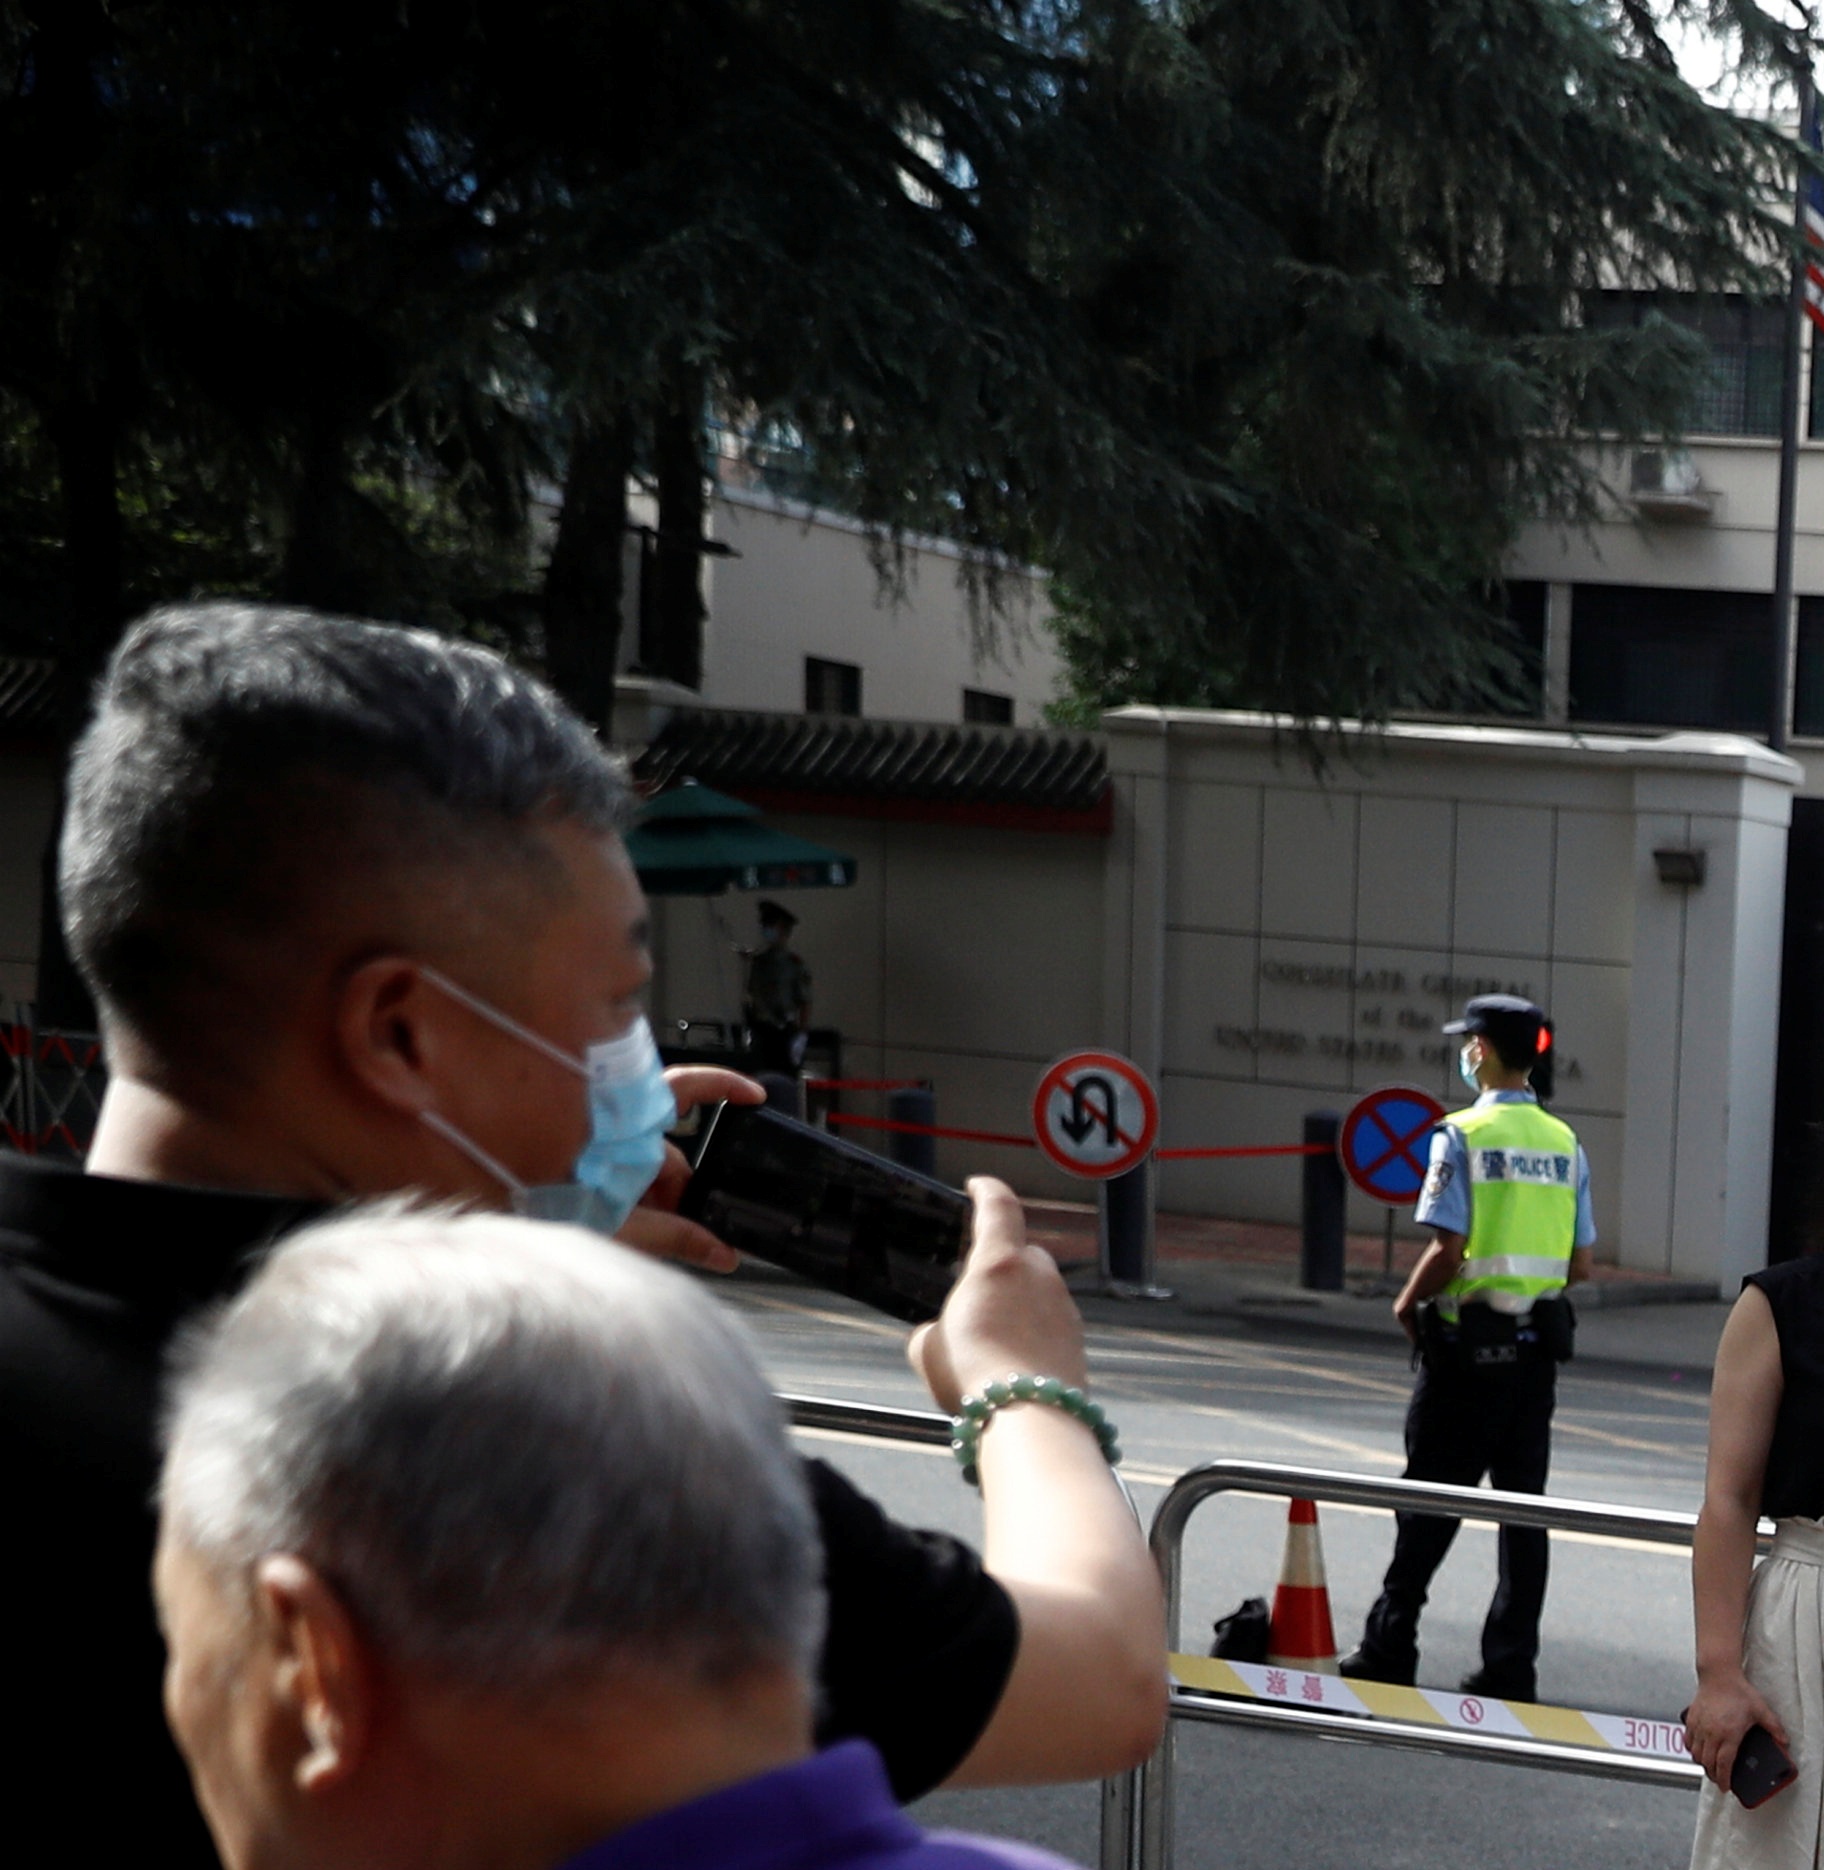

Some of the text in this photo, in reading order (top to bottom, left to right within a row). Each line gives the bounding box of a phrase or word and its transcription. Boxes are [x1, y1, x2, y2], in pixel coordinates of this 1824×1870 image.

[1511, 1156, 1552, 1177] POLICE
[1266, 1669, 1323, 1702] 警察
[1625, 1720, 1686, 1754] OLICE
